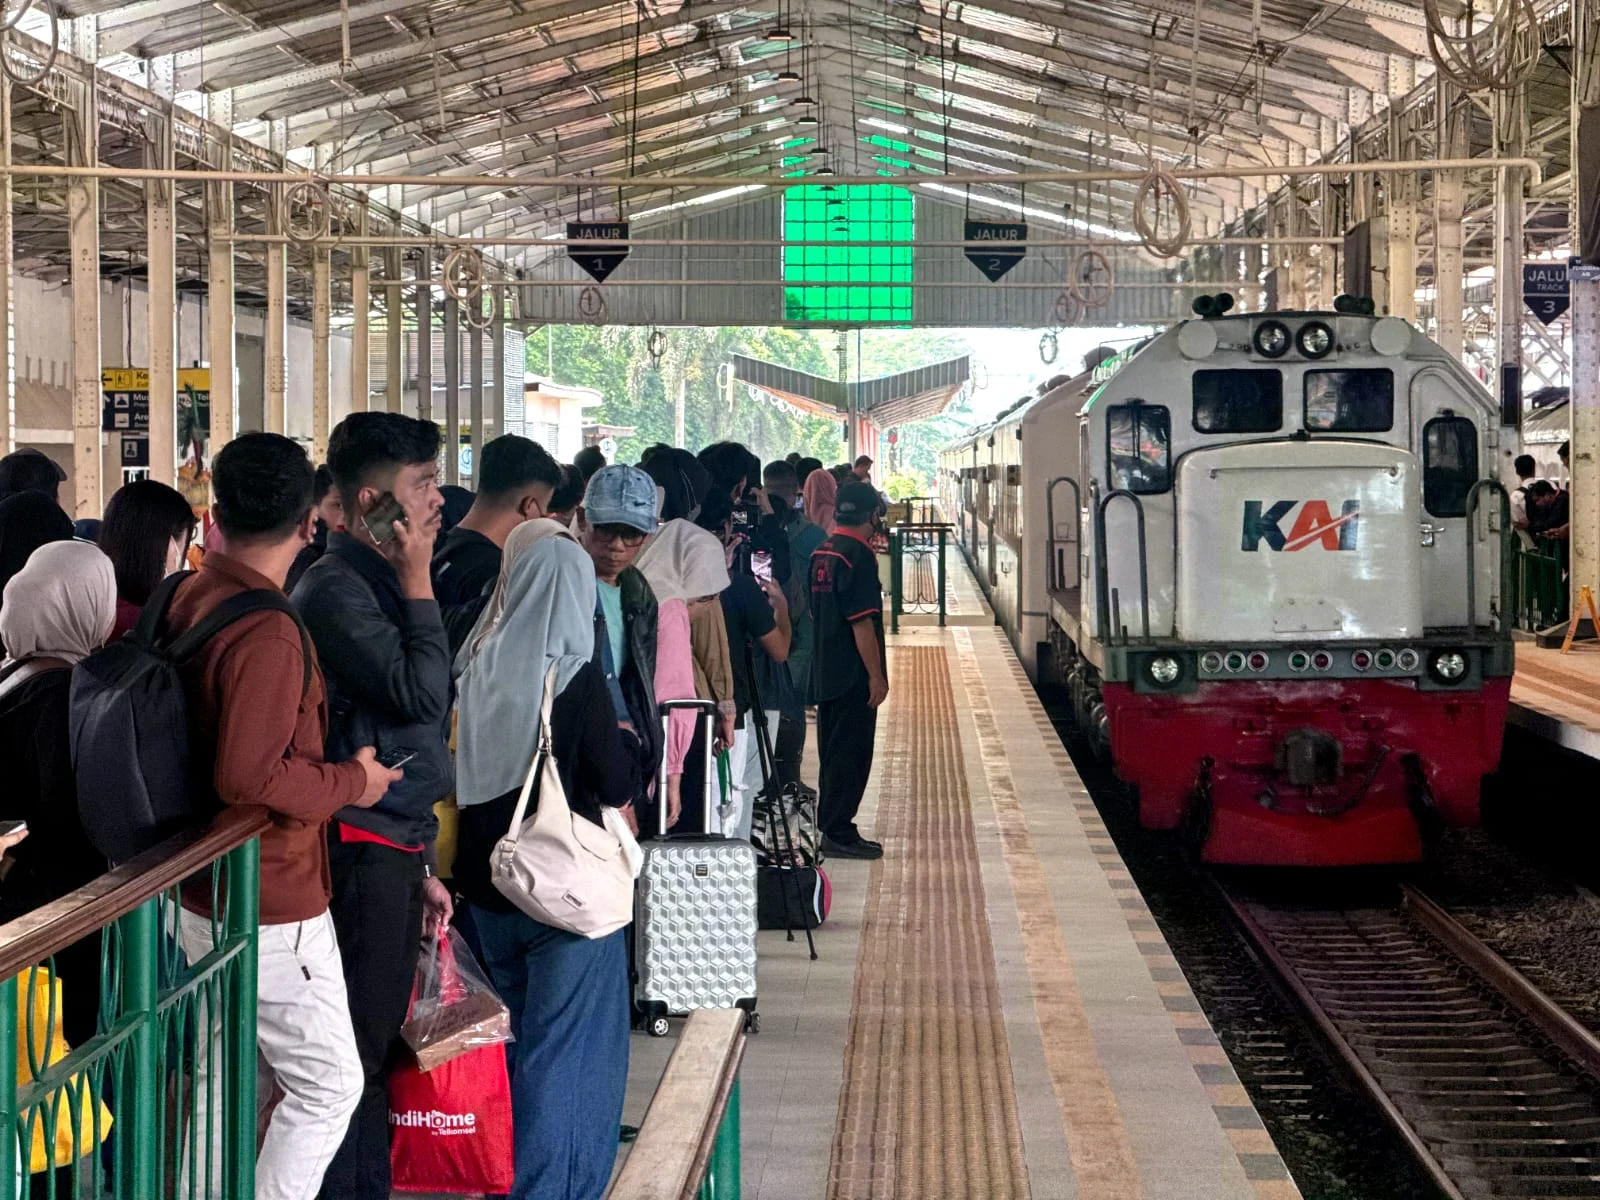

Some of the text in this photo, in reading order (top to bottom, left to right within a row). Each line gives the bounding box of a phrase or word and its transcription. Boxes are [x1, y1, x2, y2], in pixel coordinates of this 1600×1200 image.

[576, 228, 620, 239] JALUR
[973, 229, 1018, 240] JALUR
[592, 258, 605, 271] 1
[988, 258, 1001, 271] 2
[1528, 270, 1565, 282] JALU
[1543, 300, 1556, 314] 3
[136, 371, 149, 380] Ke
[1241, 499, 1361, 552] KAI
[439, 1126, 476, 1136] Telkomsel
